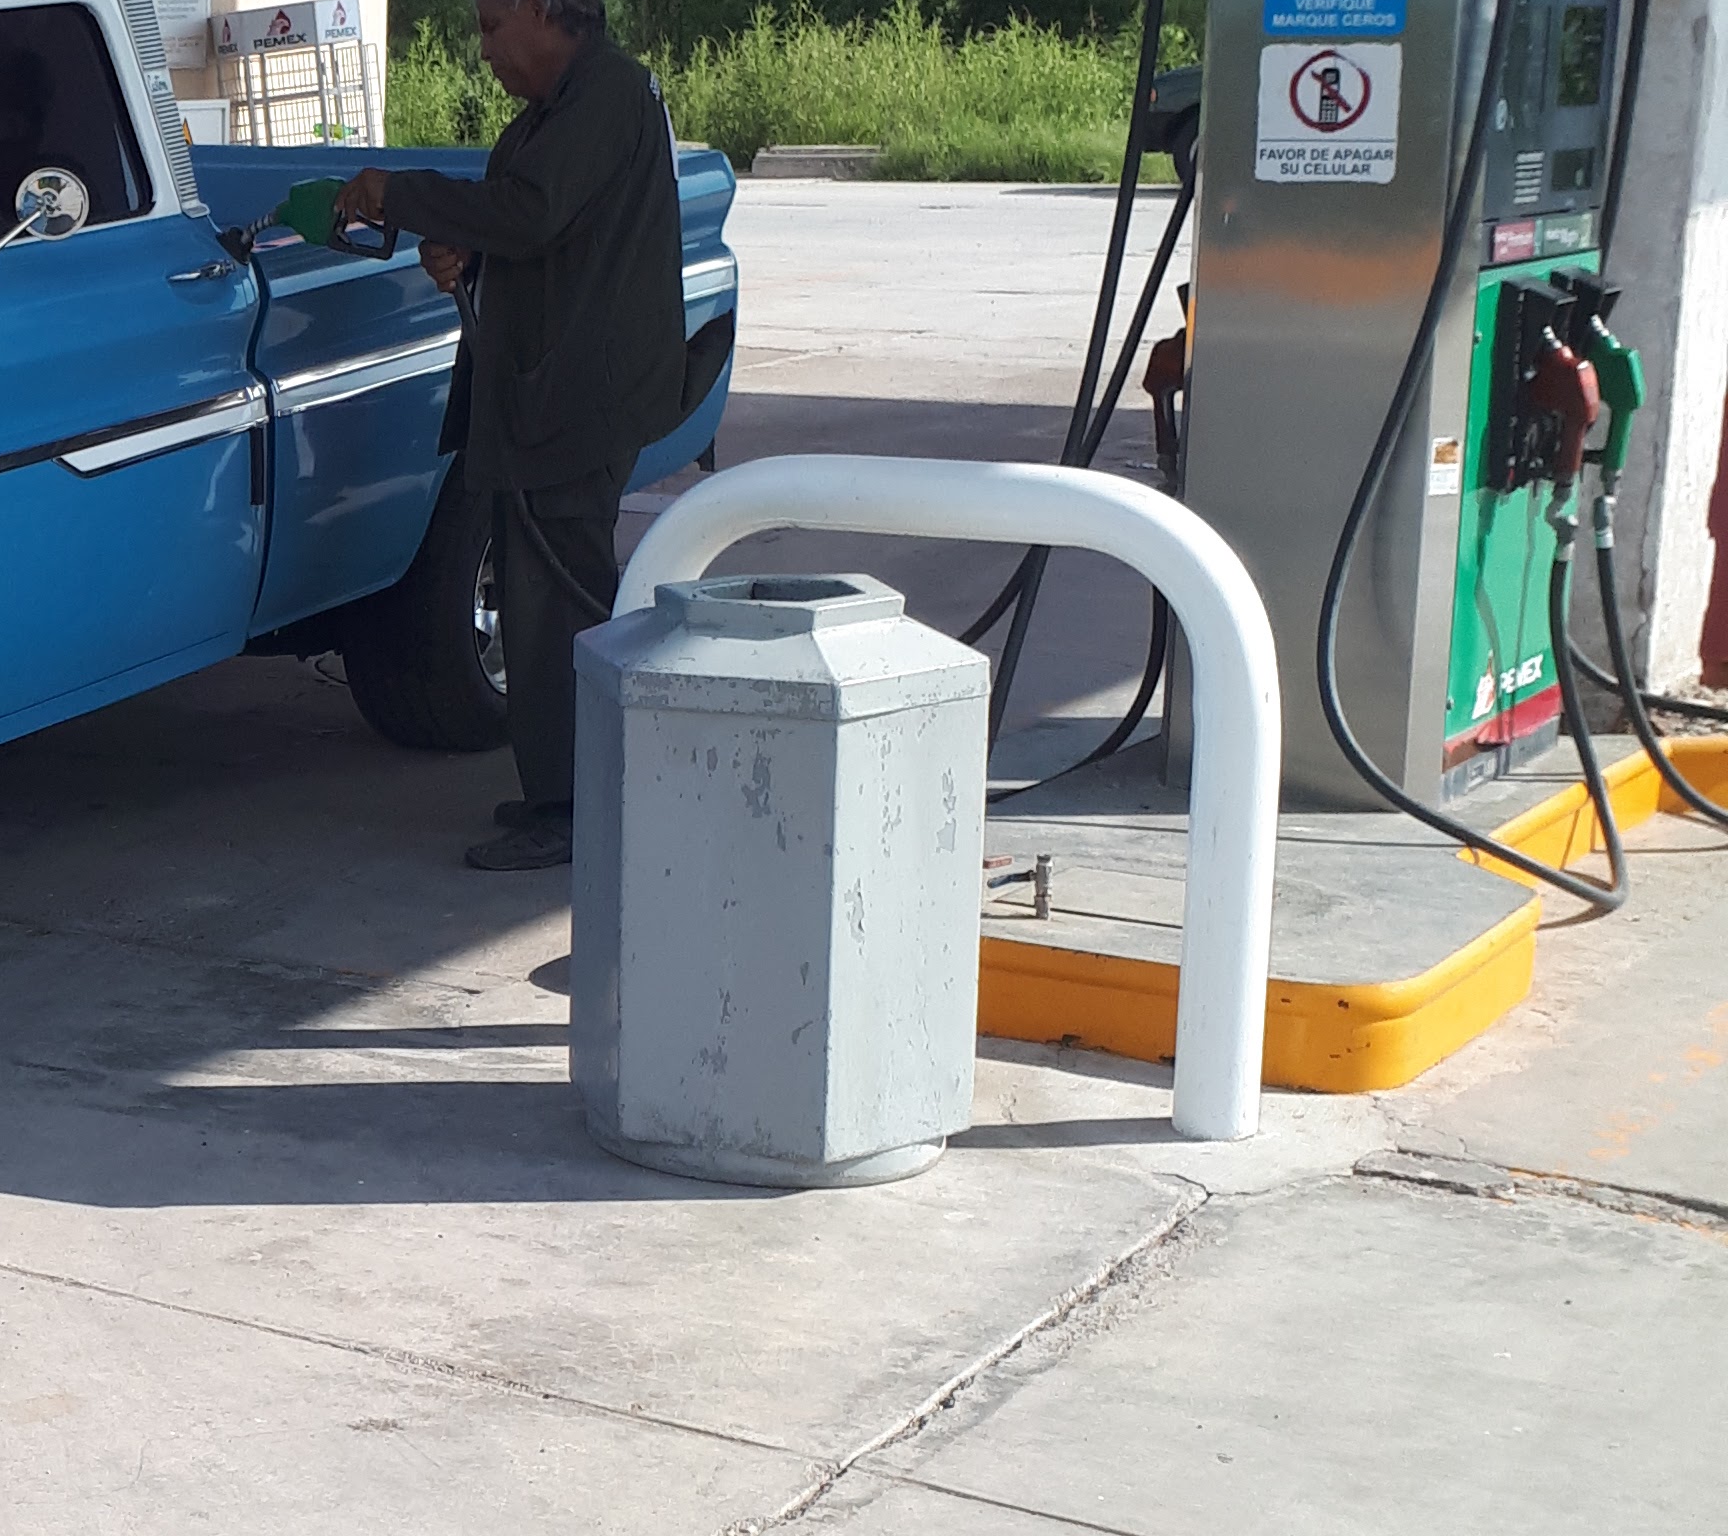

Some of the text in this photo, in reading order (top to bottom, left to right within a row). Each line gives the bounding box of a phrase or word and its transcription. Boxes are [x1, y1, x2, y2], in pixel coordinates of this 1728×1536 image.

[1273, 14, 1396, 27] MARQUE CEROS
[325, 26, 357, 39] PEMEX
[253, 33, 308, 50] PEMEX
[1259, 148, 1394, 161] FAVOR DE APAGAR
[1280, 163, 1371, 176] SU CELULAR
